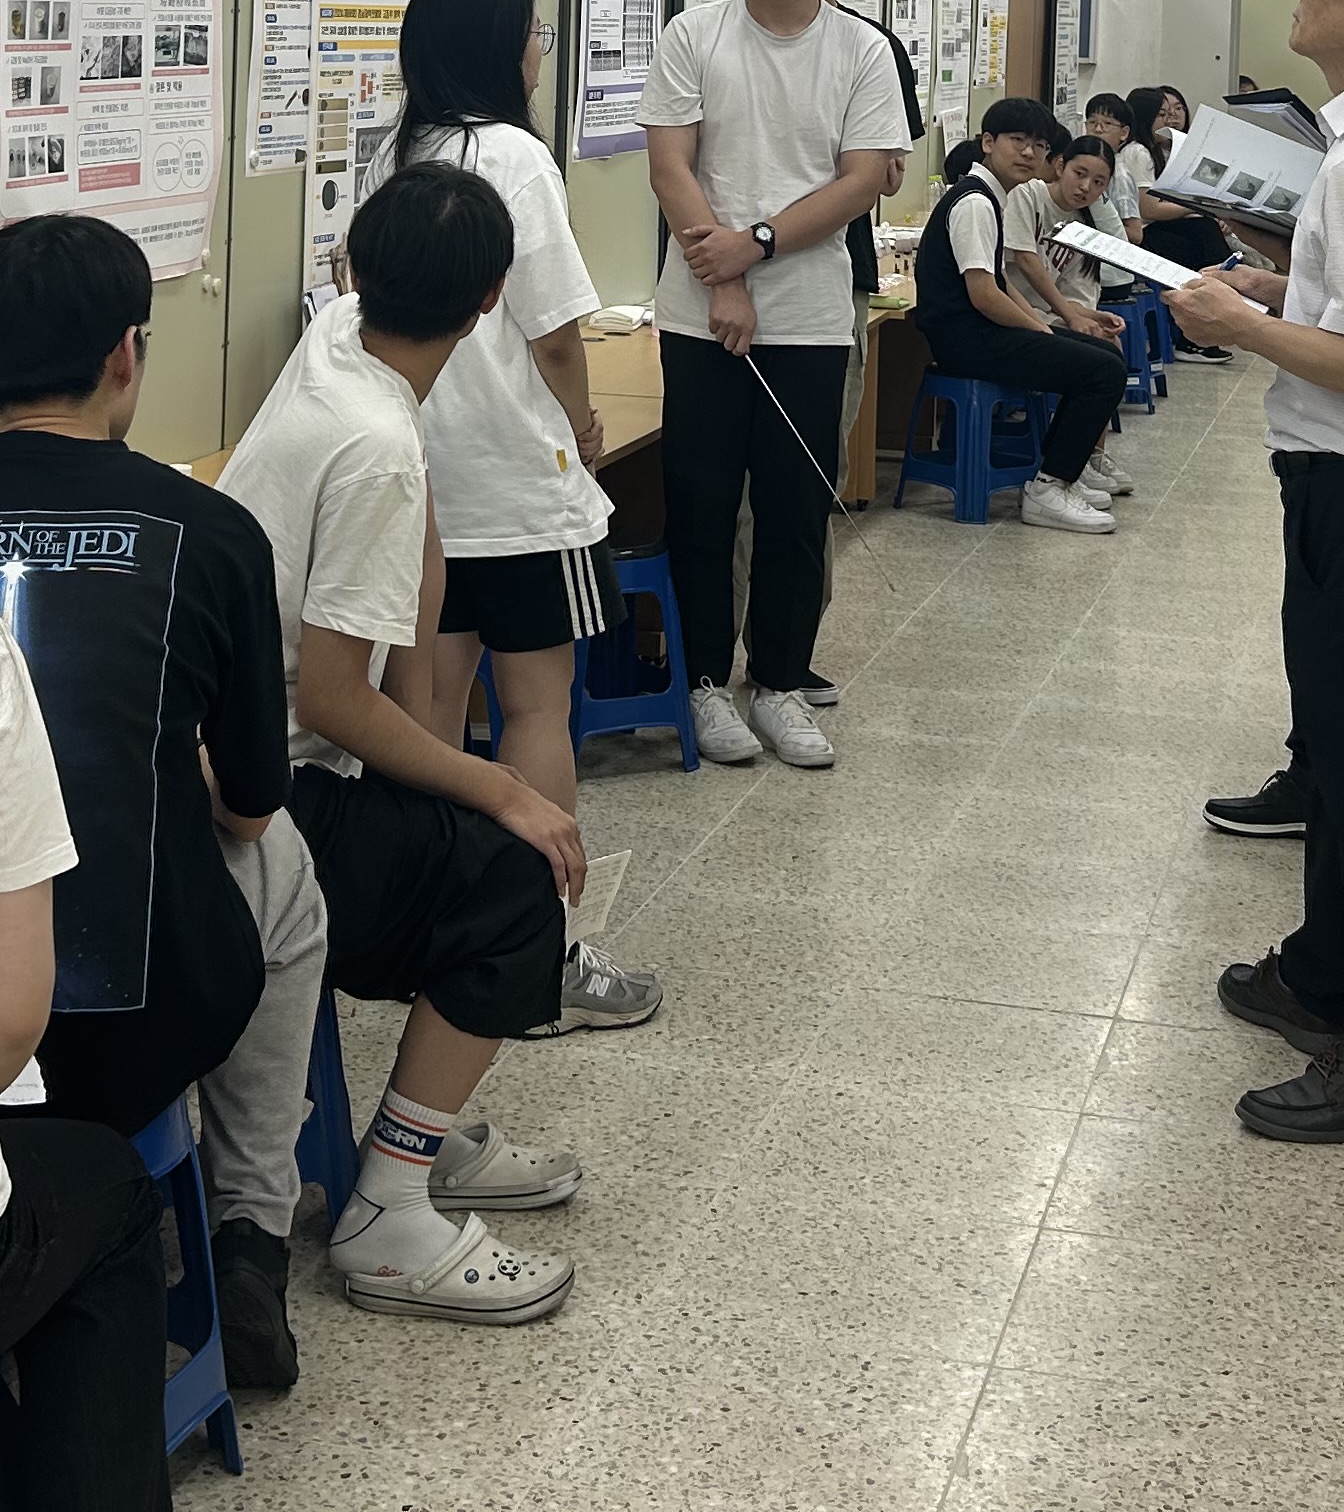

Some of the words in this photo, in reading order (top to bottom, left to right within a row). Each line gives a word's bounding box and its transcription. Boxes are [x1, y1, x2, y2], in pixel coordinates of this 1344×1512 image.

[34, 542, 67, 555] THE
[36, 530, 60, 542] OF
[65, 530, 140, 568] JEDI
